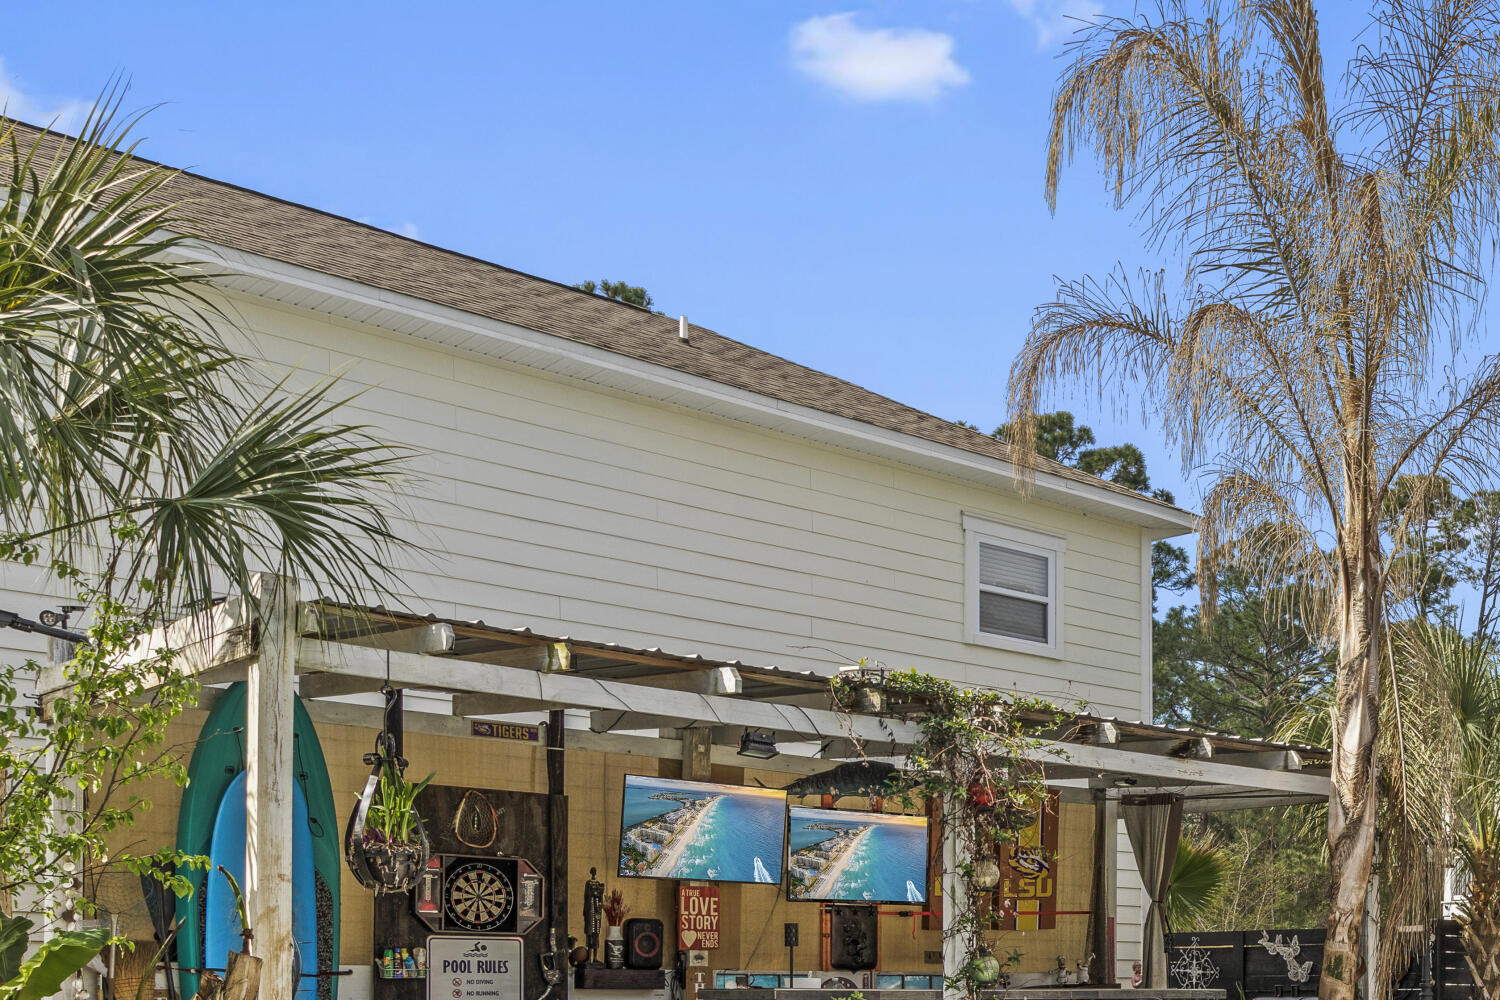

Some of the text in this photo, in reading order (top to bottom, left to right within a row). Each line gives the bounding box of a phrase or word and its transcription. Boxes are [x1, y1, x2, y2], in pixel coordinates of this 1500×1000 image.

[492, 725, 529, 740] TIGERS
[681, 889, 700, 897] A TRUE
[1003, 878, 1053, 898] LSU
[681, 896, 719, 916] LOVE
[681, 915, 718, 930] STORY
[697, 931, 719, 940] NEVER
[701, 940, 719, 948] ENDS
[443, 960, 472, 974] POOL
[477, 960, 509, 974] RULES
